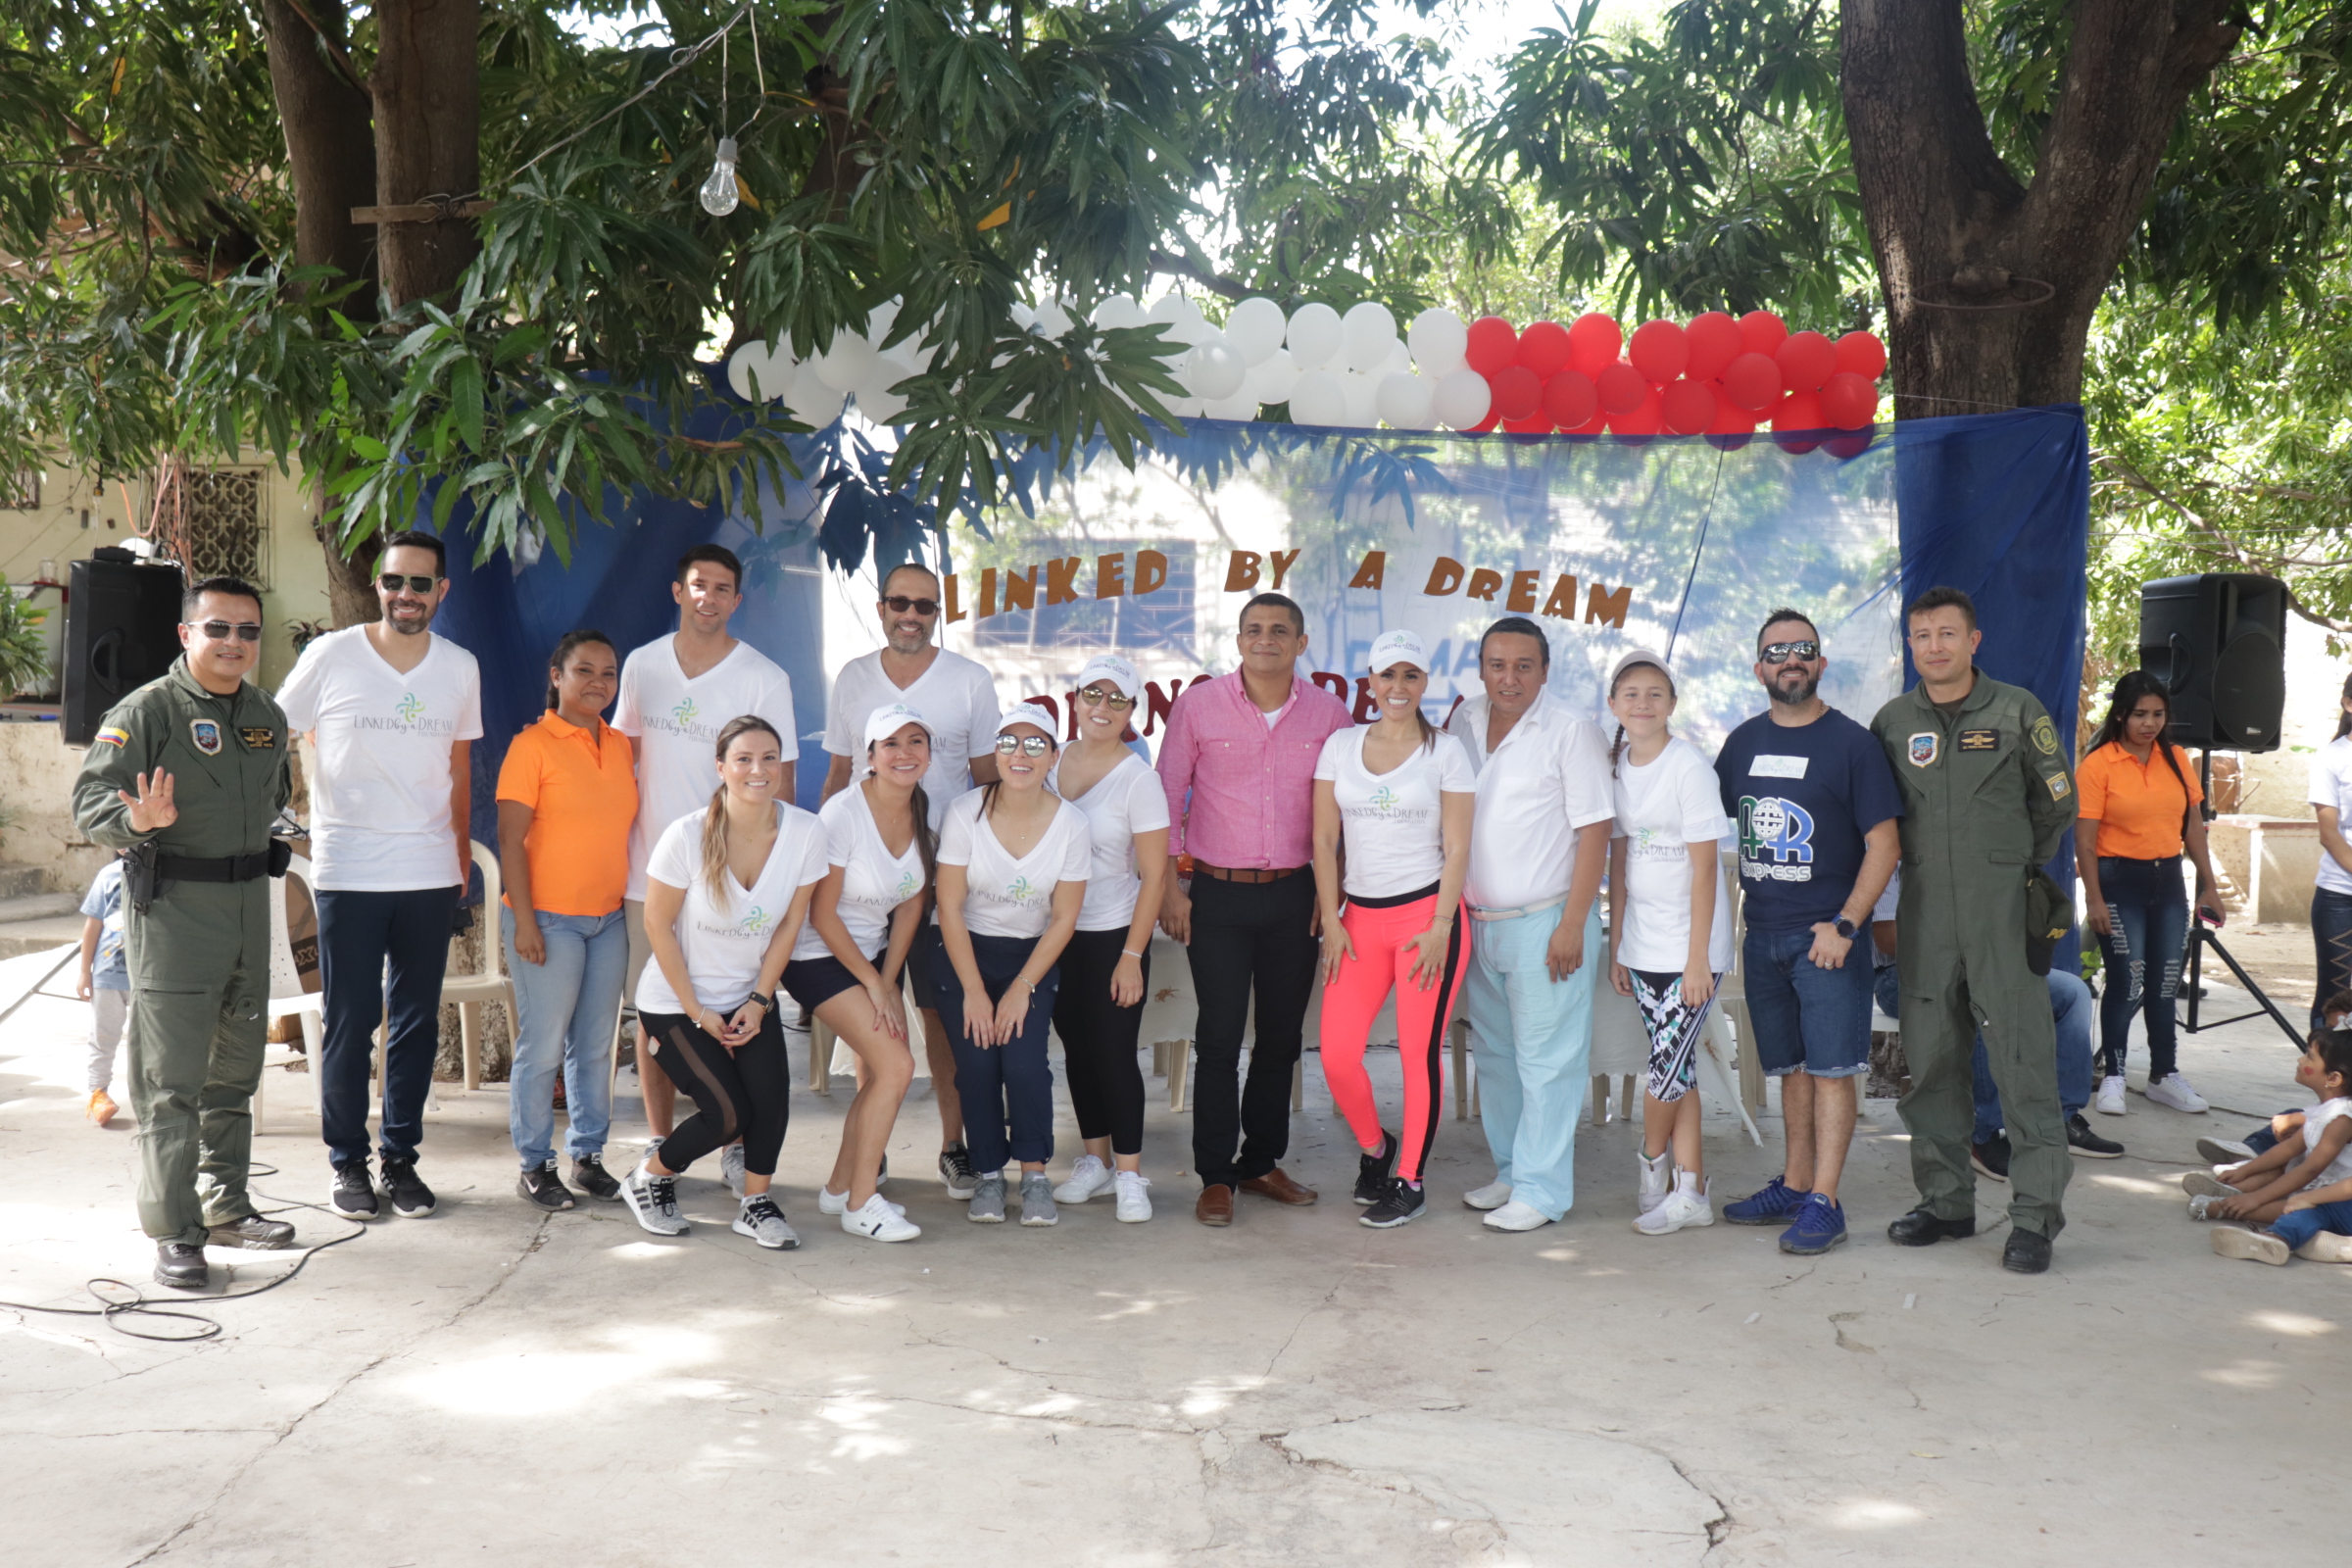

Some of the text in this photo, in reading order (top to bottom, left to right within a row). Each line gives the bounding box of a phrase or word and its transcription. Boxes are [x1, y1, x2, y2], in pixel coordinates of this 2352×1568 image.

[944, 549, 1633, 628] LINKED BY A DREAM
[354, 714, 394, 730] LINKED
[394, 717, 407, 735] by
[1393, 808, 1429, 819] DREAM
[1649, 844, 1685, 858] DREAM
